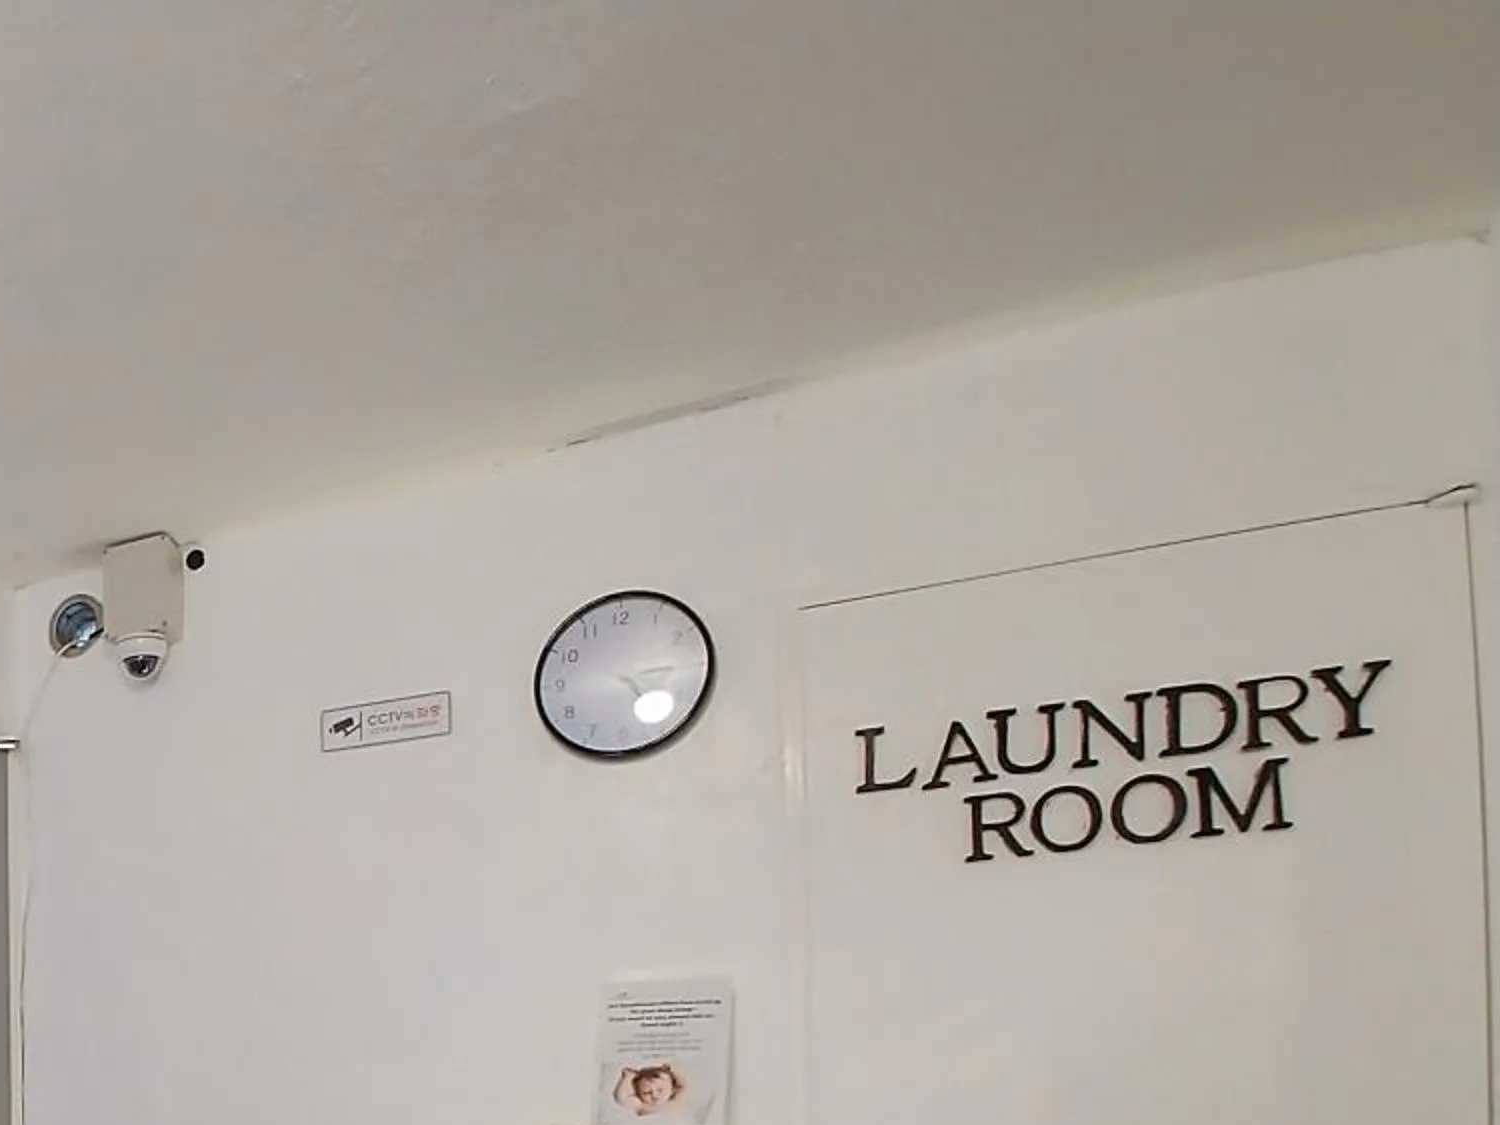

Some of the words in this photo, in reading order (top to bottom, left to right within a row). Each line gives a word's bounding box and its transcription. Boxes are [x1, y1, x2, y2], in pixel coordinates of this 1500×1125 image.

[612, 611, 630, 625] 12
[583, 624, 598, 638] 11
[561, 649, 579, 664] 10
[555, 679, 565, 692] 9
[564, 705, 574, 719] 8
[855, 659, 1392, 795] LAUNDRY
[963, 757, 1293, 863] ROOM
